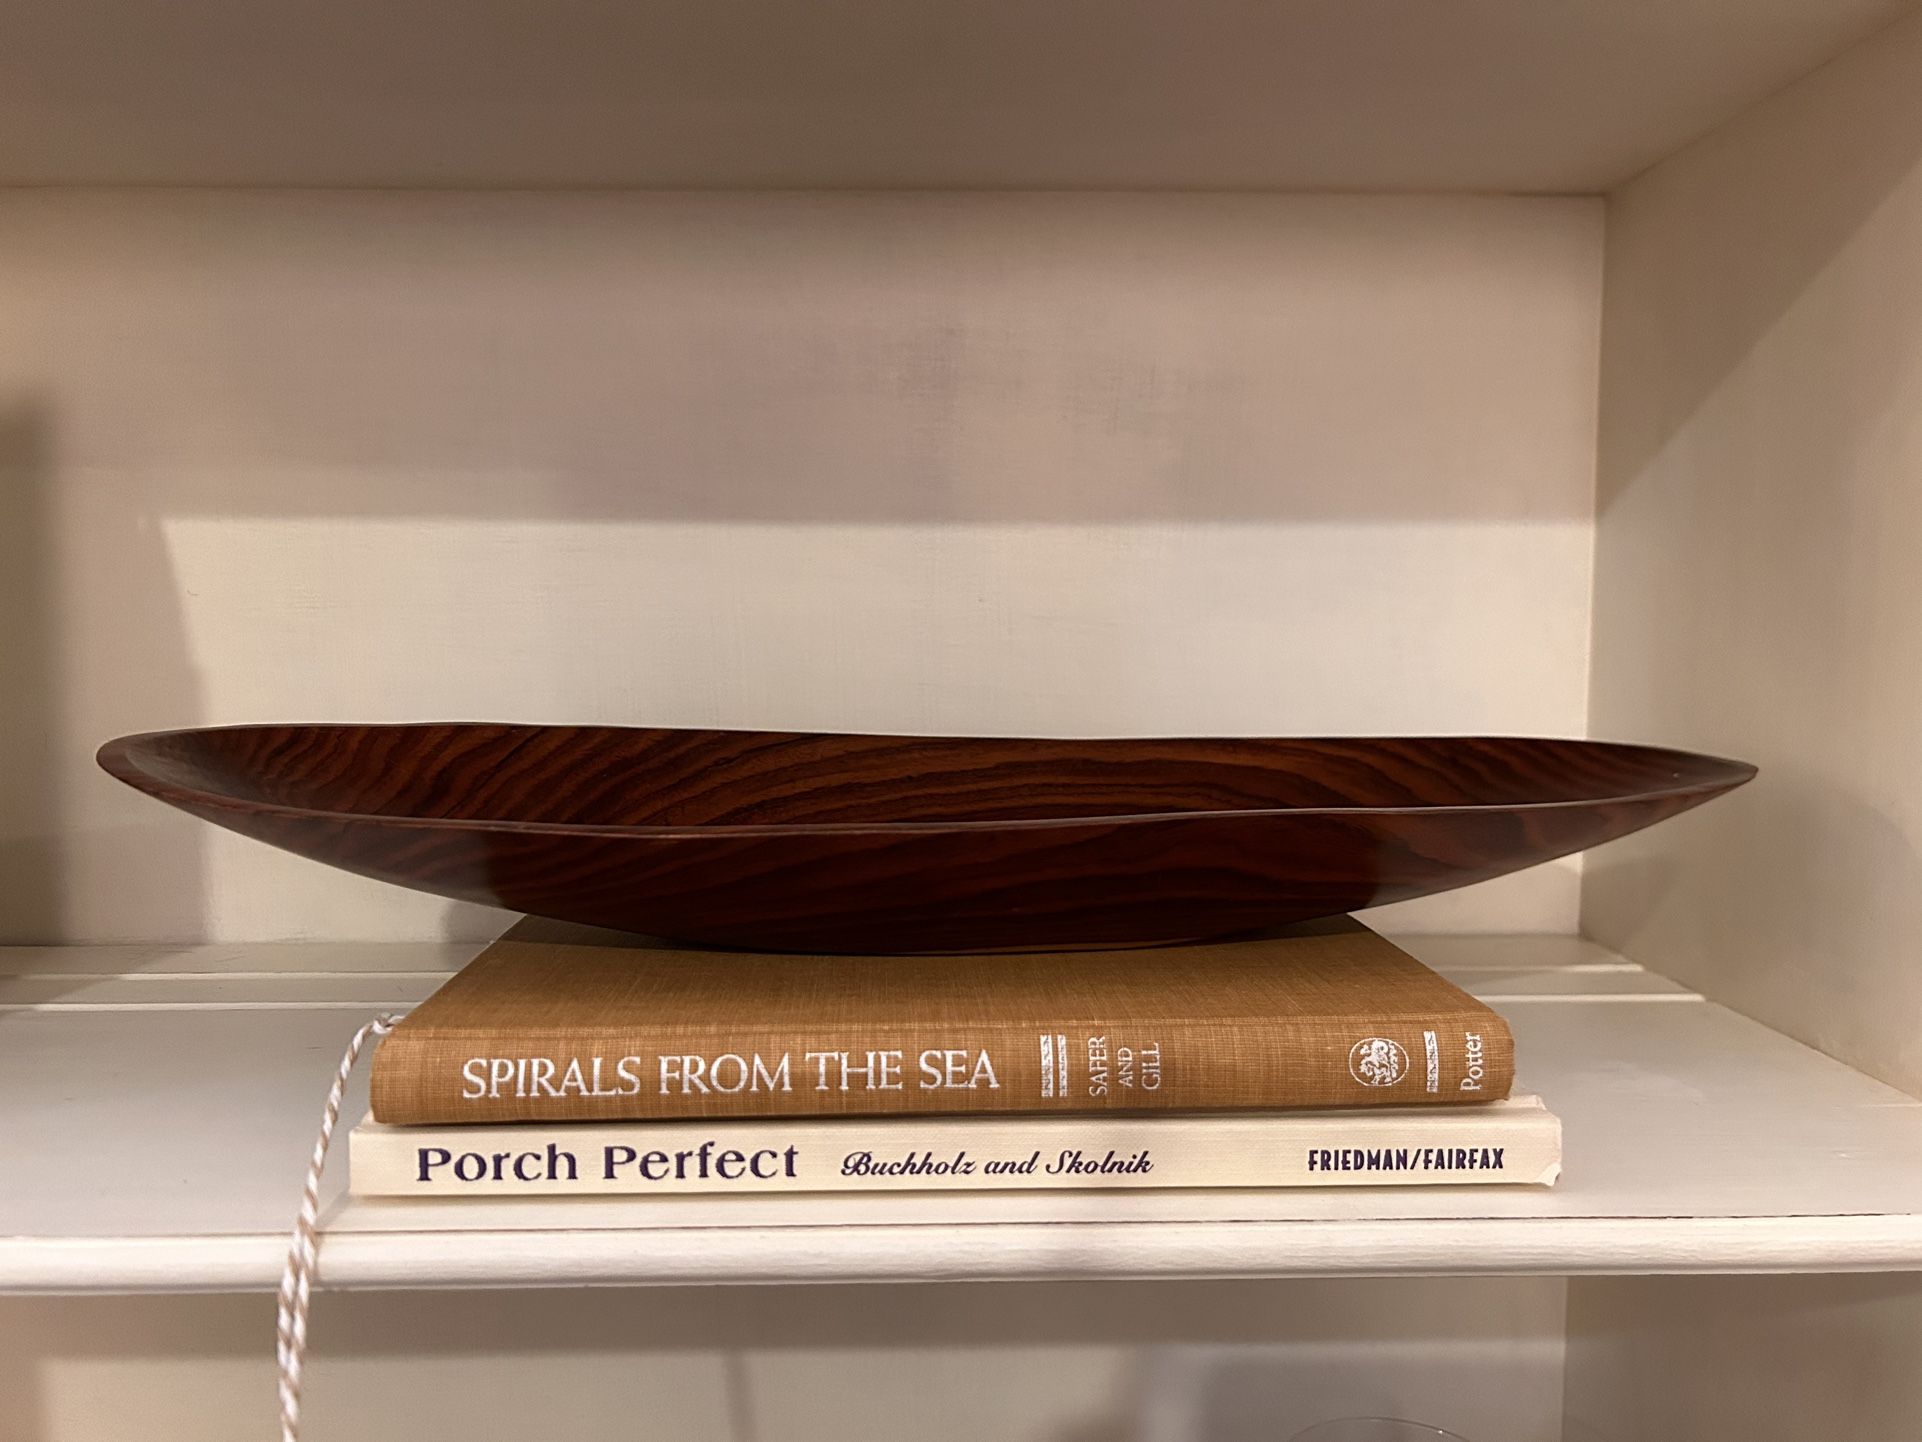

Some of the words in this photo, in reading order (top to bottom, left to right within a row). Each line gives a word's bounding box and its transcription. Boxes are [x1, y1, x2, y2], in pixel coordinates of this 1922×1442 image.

[462, 1056, 641, 1098] SPIRALS
[658, 1053, 793, 1094] FROM
[805, 1050, 903, 1090] THE
[919, 1048, 1000, 1090] SEA
[1088, 1035, 1108, 1097] SAFER
[1117, 1047, 1133, 1088] AND
[1141, 1042, 1161, 1090] GILL
[1460, 1031, 1484, 1092] Potter
[416, 1143, 578, 1182] Porch
[603, 1141, 800, 1180] Perfect
[841, 1151, 976, 1176] Buchholz
[984, 1151, 1039, 1175] and
[1045, 1150, 1154, 1175] Skolnik
[1308, 1148, 1504, 1171] FRIEDMAN/FAIRFAX
